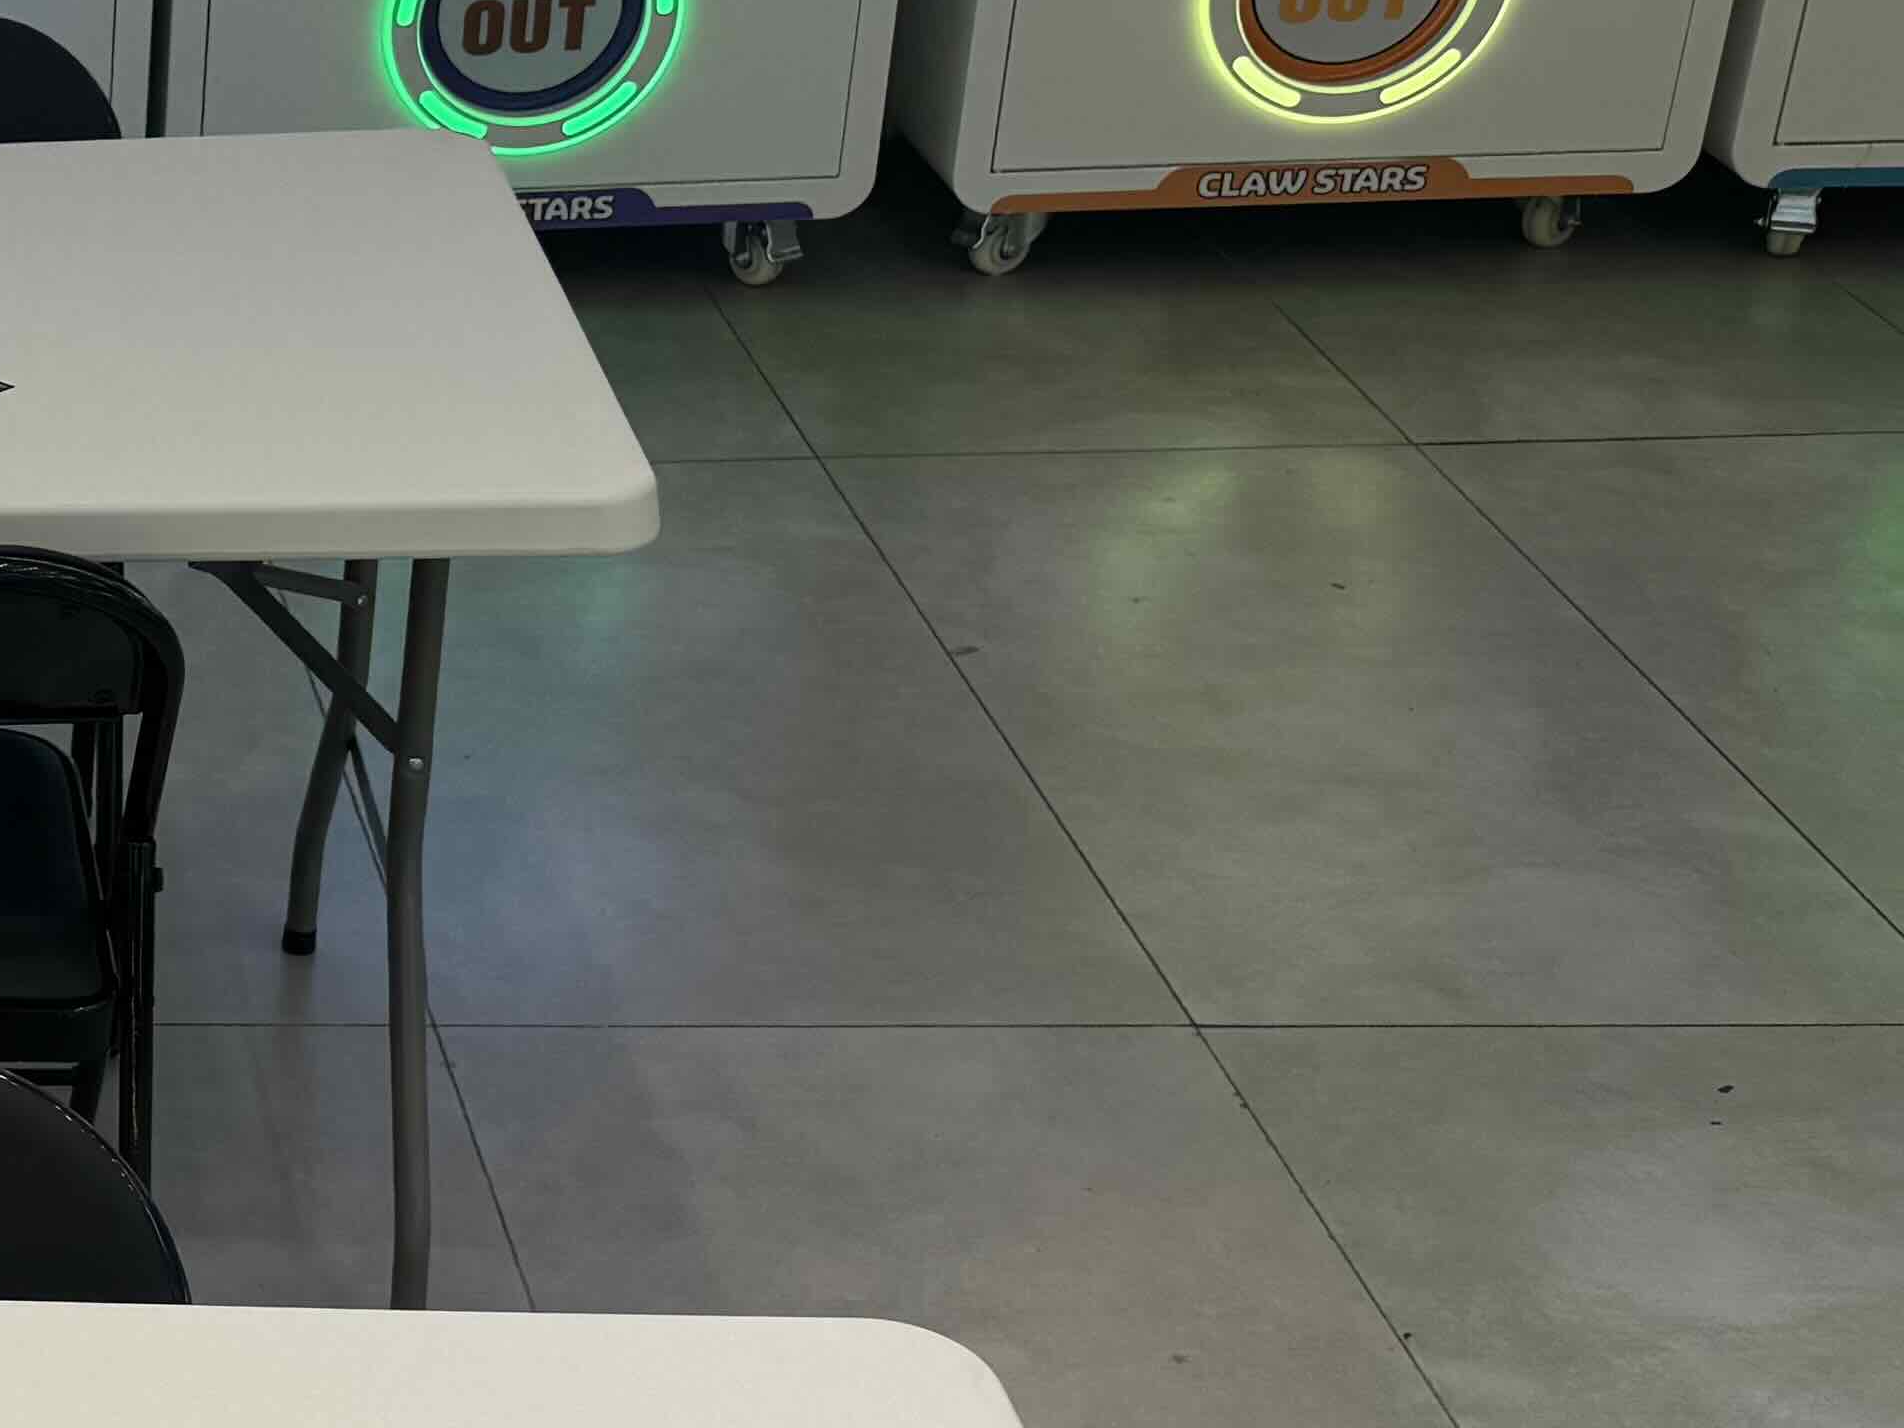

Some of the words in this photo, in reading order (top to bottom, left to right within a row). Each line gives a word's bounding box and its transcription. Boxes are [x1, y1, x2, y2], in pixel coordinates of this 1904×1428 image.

[1197, 169, 1307, 197] CLAW
[1315, 165, 1427, 193] STARS
[517, 196, 614, 221] TARS
